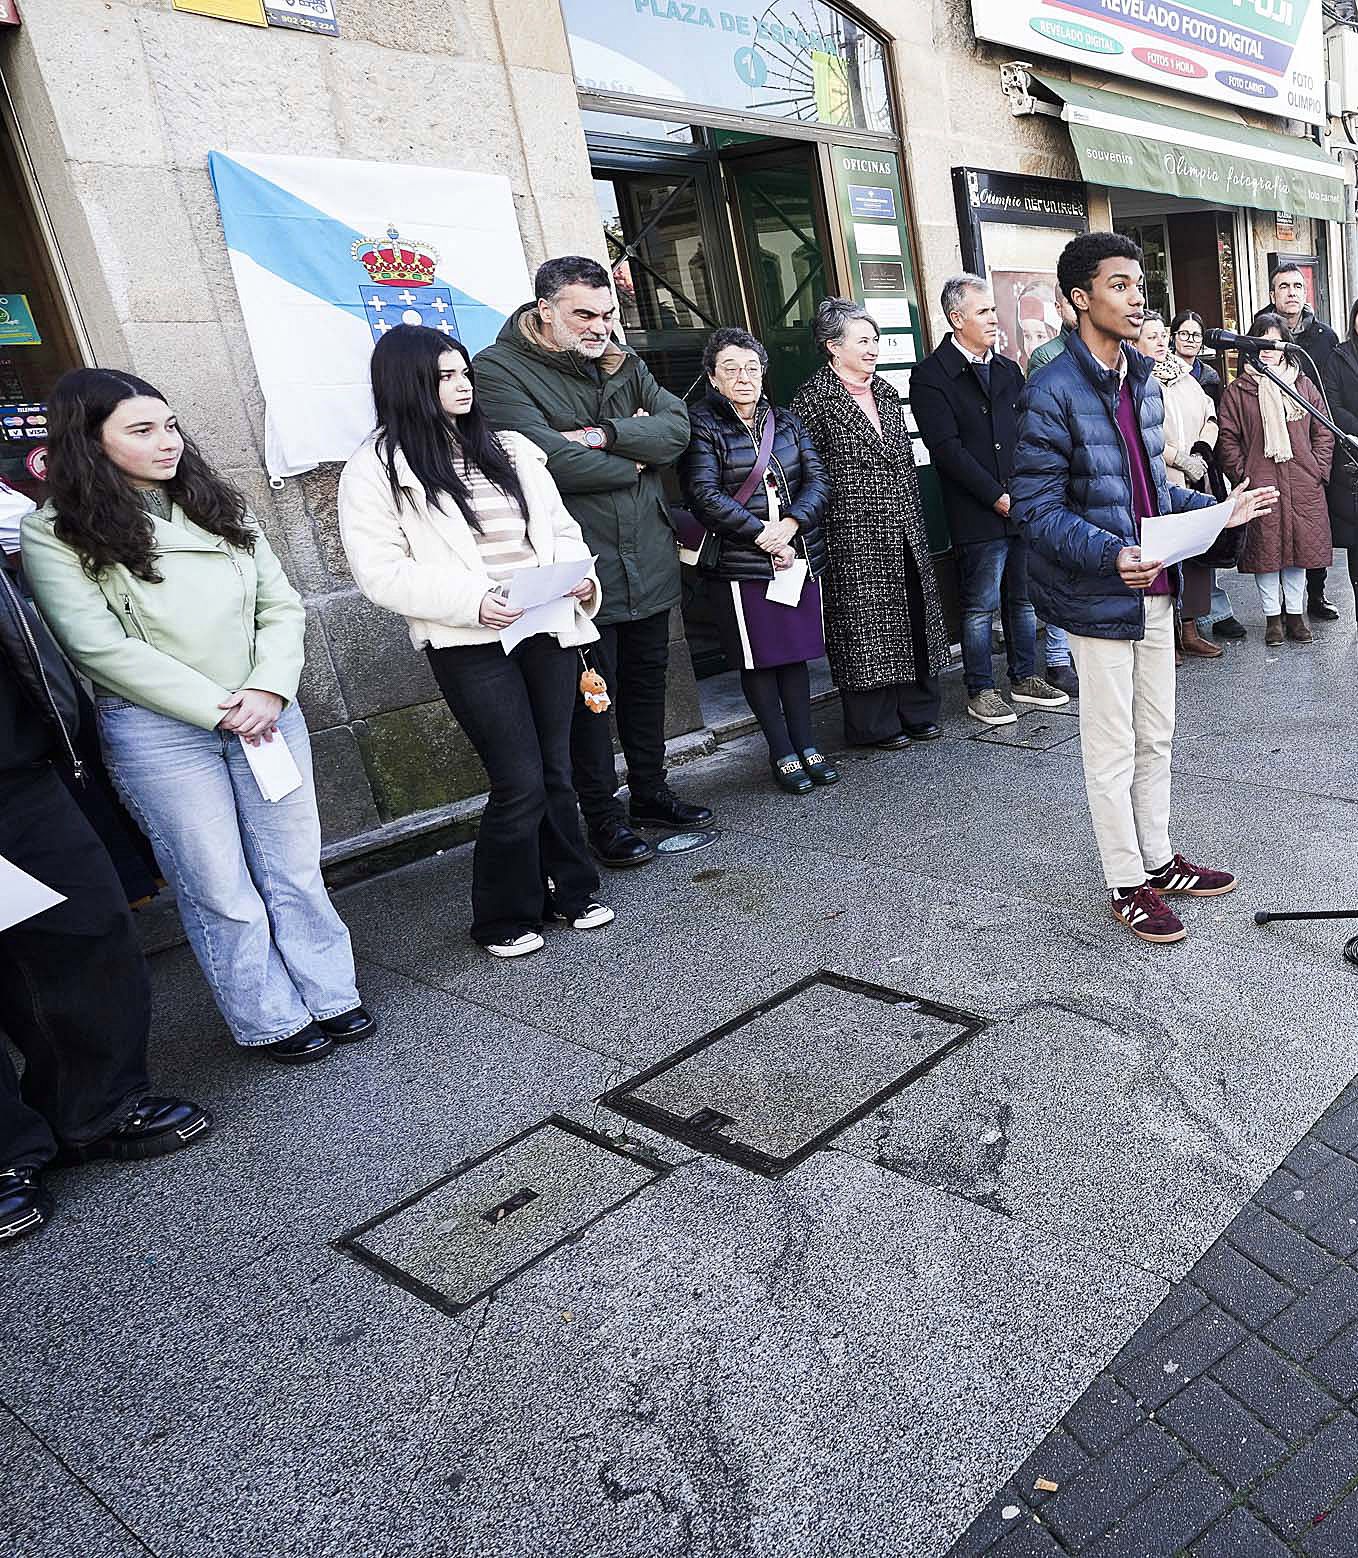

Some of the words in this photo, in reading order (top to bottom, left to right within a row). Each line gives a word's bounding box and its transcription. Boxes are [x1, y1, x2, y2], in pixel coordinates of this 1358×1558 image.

[720, 12, 750, 35] DE
[1040, 21, 1083, 41] REVELADO
[1183, 16, 1218, 43] FOTO
[1220, 29, 1265, 59] DIGITAL
[743, 52, 757, 80] 1
[1147, 52, 1170, 68] FOTOS
[1176, 61, 1195, 75] HORA
[1229, 75, 1243, 88] FOTO
[1292, 72, 1314, 90] FOTO
[1287, 91, 1322, 114] OLIMPIO
[843, 158, 891, 174] OFICINAS
[1164, 153, 1219, 187] Olimpio
[980, 189, 1021, 210] Olimpio
